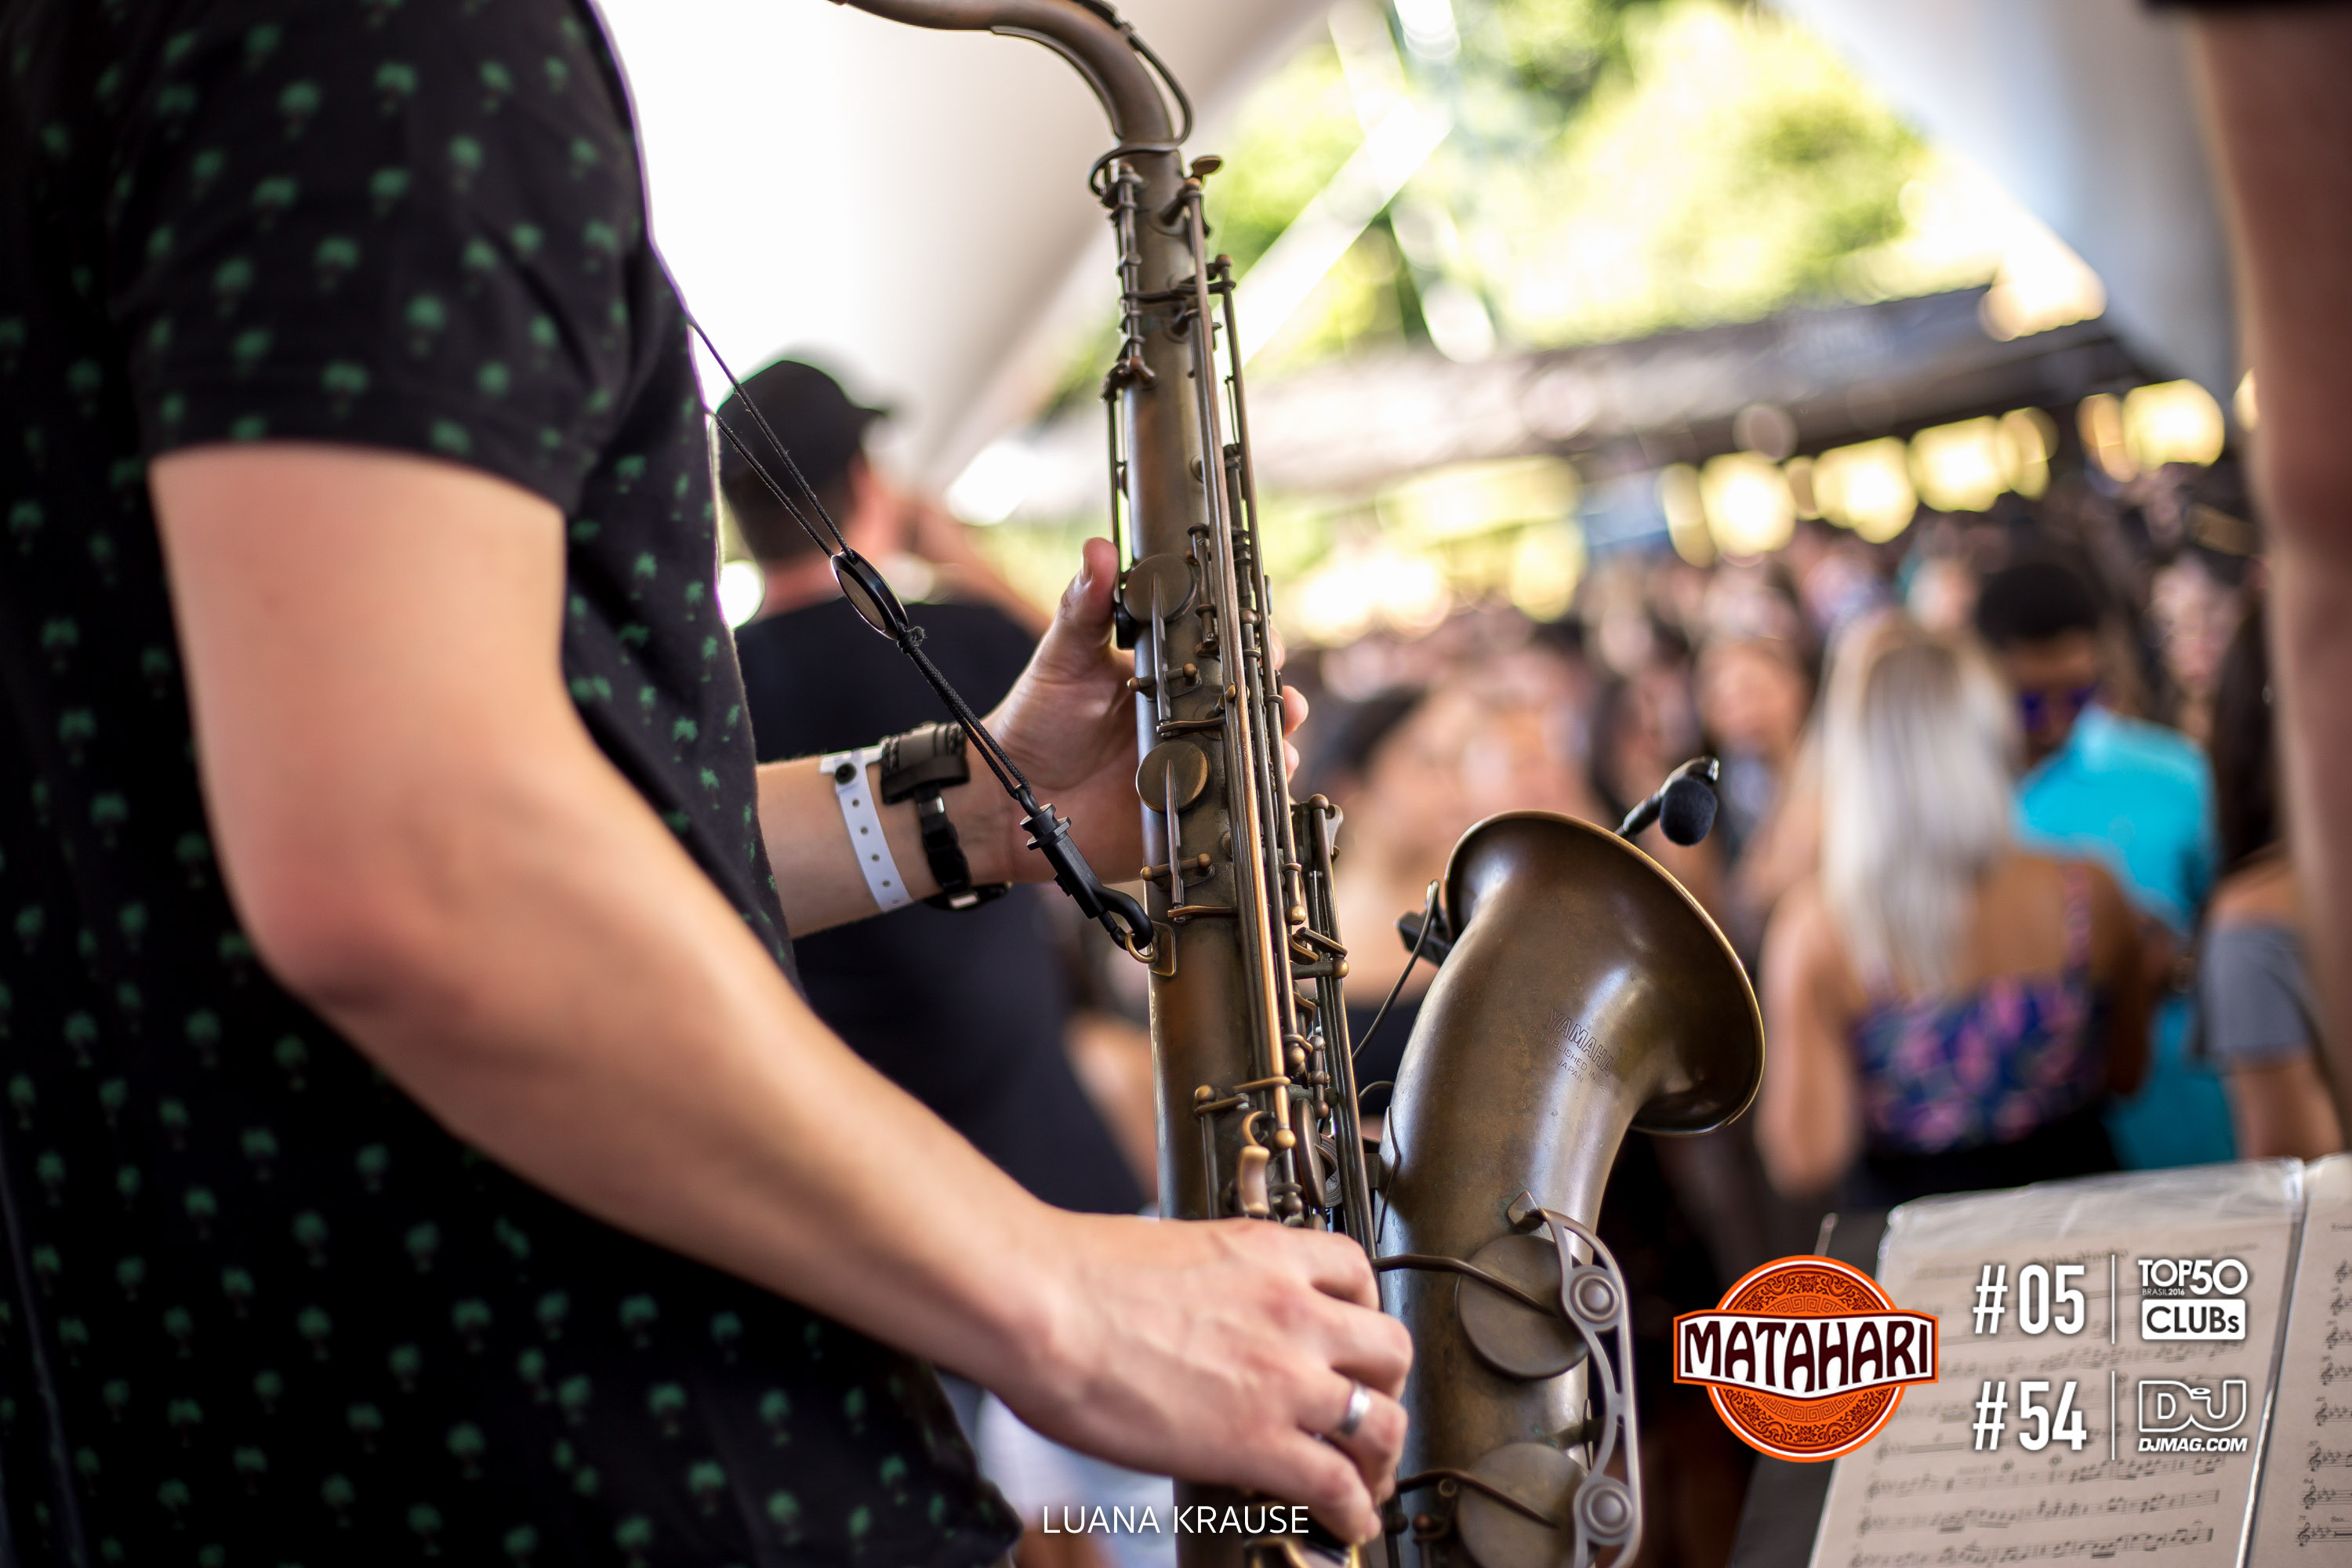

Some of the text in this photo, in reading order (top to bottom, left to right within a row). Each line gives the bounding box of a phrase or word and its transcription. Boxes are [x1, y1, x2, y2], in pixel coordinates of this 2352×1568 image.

[1527, 1025, 1588, 1071] ESTABLISHED
[1588, 1069, 1598, 1081] IN
[1548, 1008, 1613, 1077] YAMAHA
[1556, 1059, 1584, 1083] JAPAN
